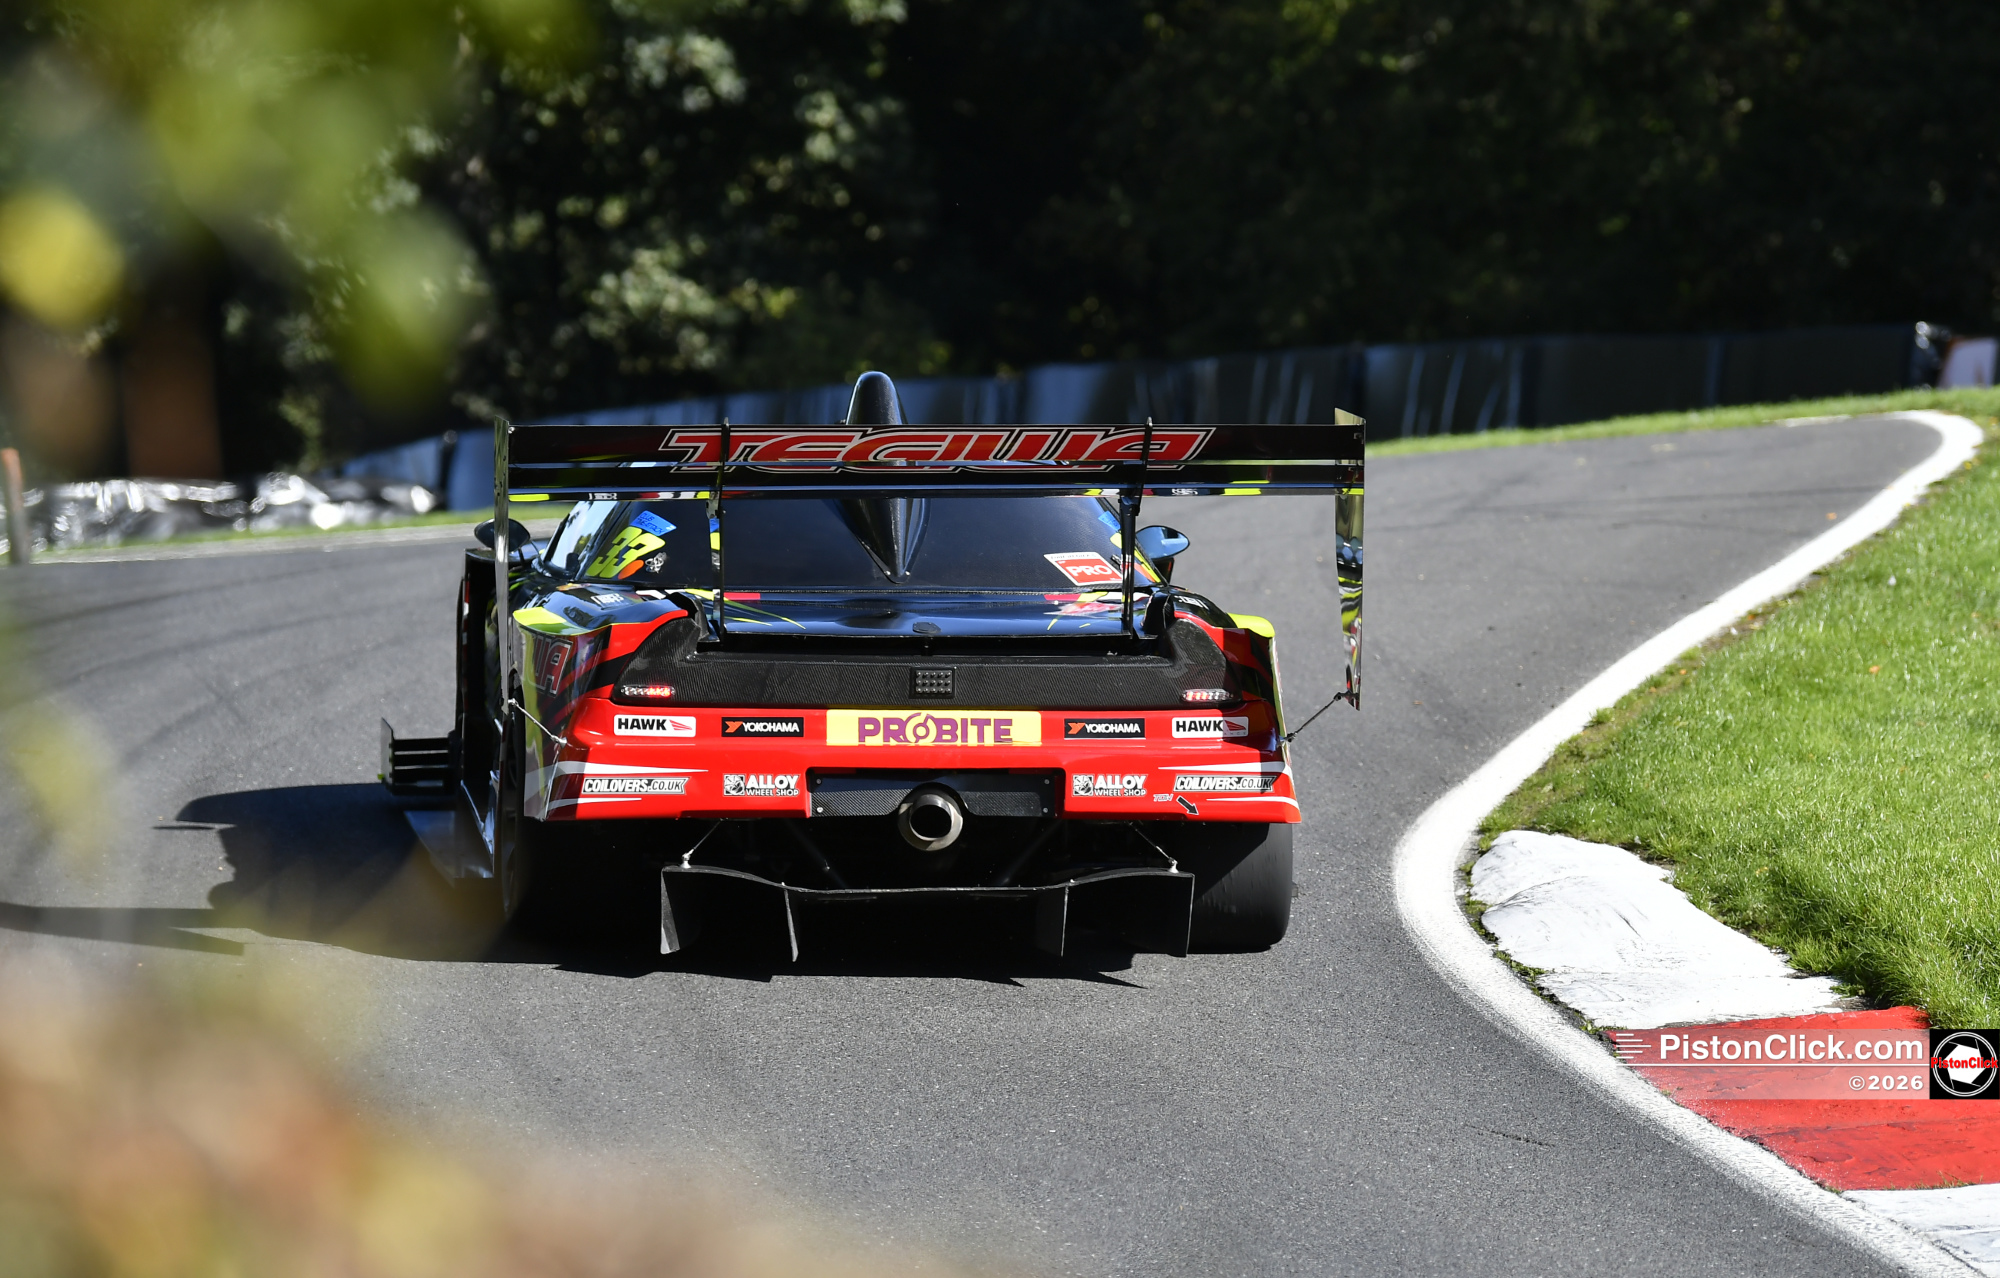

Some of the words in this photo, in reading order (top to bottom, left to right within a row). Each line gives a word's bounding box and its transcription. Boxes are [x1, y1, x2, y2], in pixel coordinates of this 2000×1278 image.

[585, 526, 666, 578] 33
[1066, 565, 1112, 577] PRO
[617, 718, 668, 731] HAWK
[742, 722, 800, 733] YOKOHAMA
[858, 712, 1013, 743] PROBITE
[1085, 723, 1141, 733] YOKOHAMA
[1175, 720, 1224, 732] HAWK
[584, 778, 682, 793] COILOVERS.CO.UK
[745, 775, 799, 789] ALLOY
[1093, 775, 1147, 789] ALLOY
[1176, 777, 1272, 790] COILOVERS.CO.UK
[746, 788, 773, 796] WHEEL
[776, 788, 799, 796] SHOP
[1094, 789, 1121, 797] WHEEL
[1124, 789, 1147, 797] SHOP
